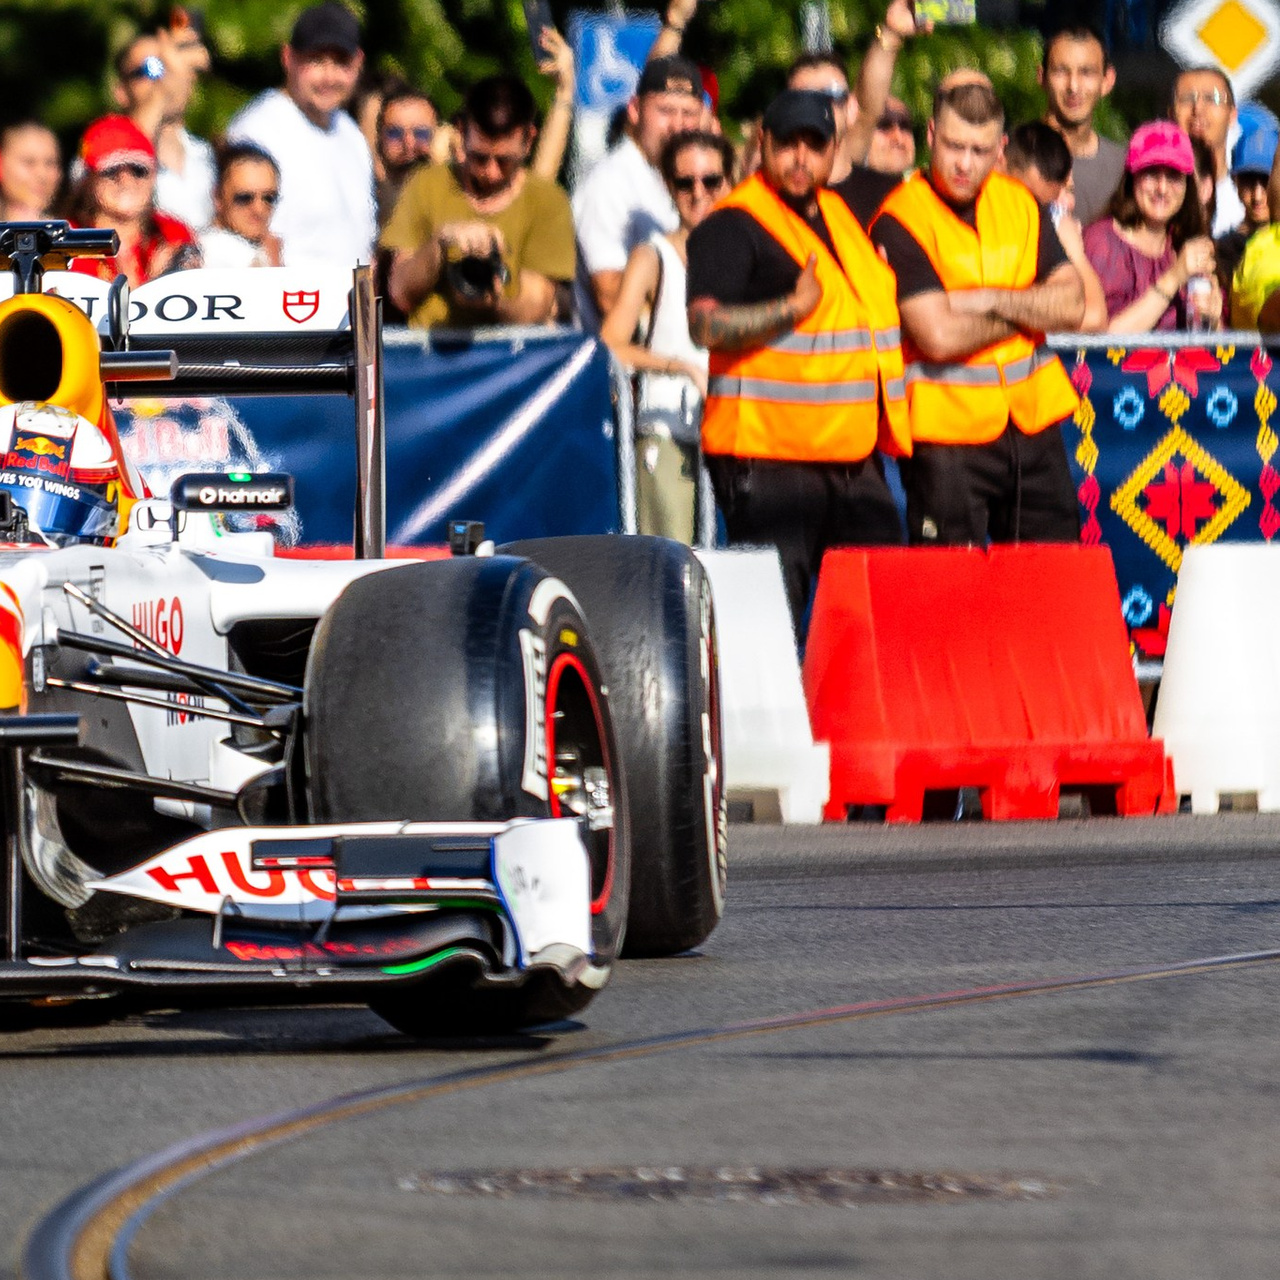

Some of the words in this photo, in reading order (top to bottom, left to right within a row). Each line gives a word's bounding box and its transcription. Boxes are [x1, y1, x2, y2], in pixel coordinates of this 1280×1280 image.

[18, 474, 42, 490] YOU
[44, 480, 81, 500] WINGS
[218, 488, 283, 504] hahnair
